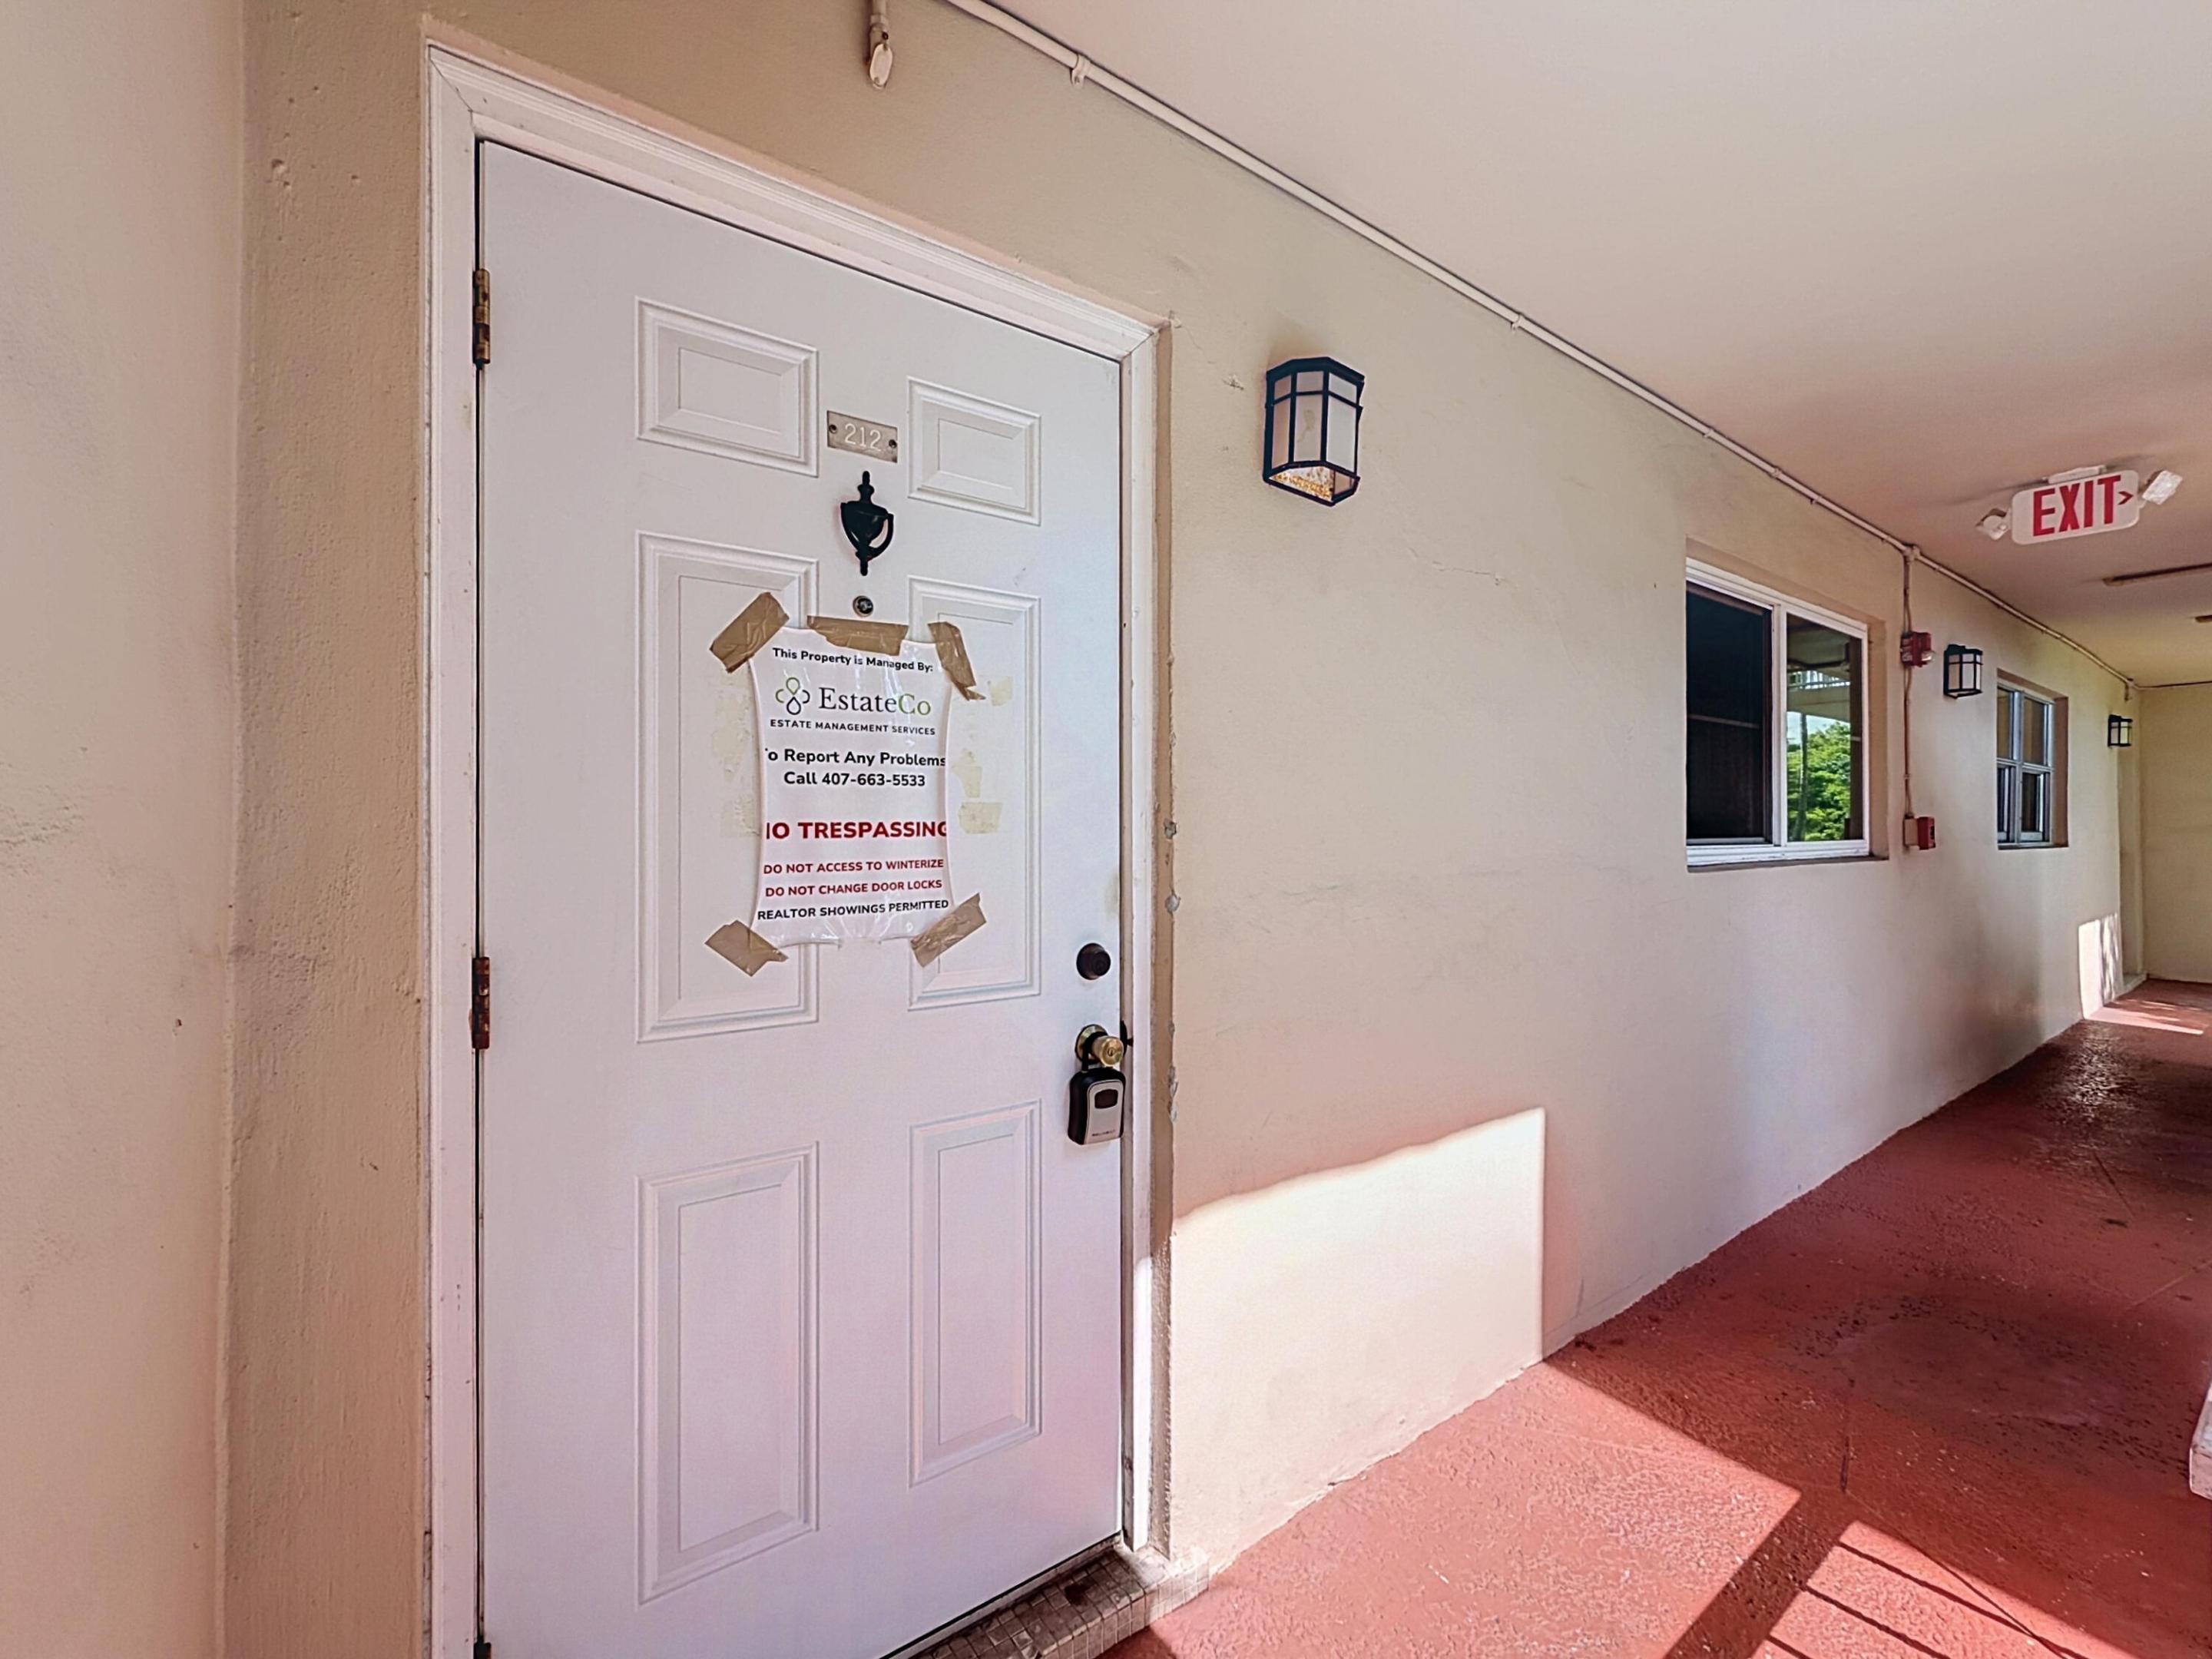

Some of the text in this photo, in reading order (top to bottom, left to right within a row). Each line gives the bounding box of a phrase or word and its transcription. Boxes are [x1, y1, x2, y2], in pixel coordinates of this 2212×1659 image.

[845, 423, 881, 452] 212
[2033, 475, 2121, 536] EXIT
[773, 647, 933, 671] This Property is Managed By:
[818, 687, 931, 716] EstateCo
[770, 720, 935, 735] ESTATE MANAGEMENT SERVICES
[765, 748, 945, 766] o Report Any Problems
[784, 772, 926, 786] Call 407-663-5533
[767, 823, 790, 839] O
[763, 859, 944, 874] DO NOT ACCESS TO WINTERIZE
[766, 880, 942, 896] DO NOT CHANGE DOOR LOCKS
[757, 899, 949, 919] REALTOR SHOWINGS PERMITTED
